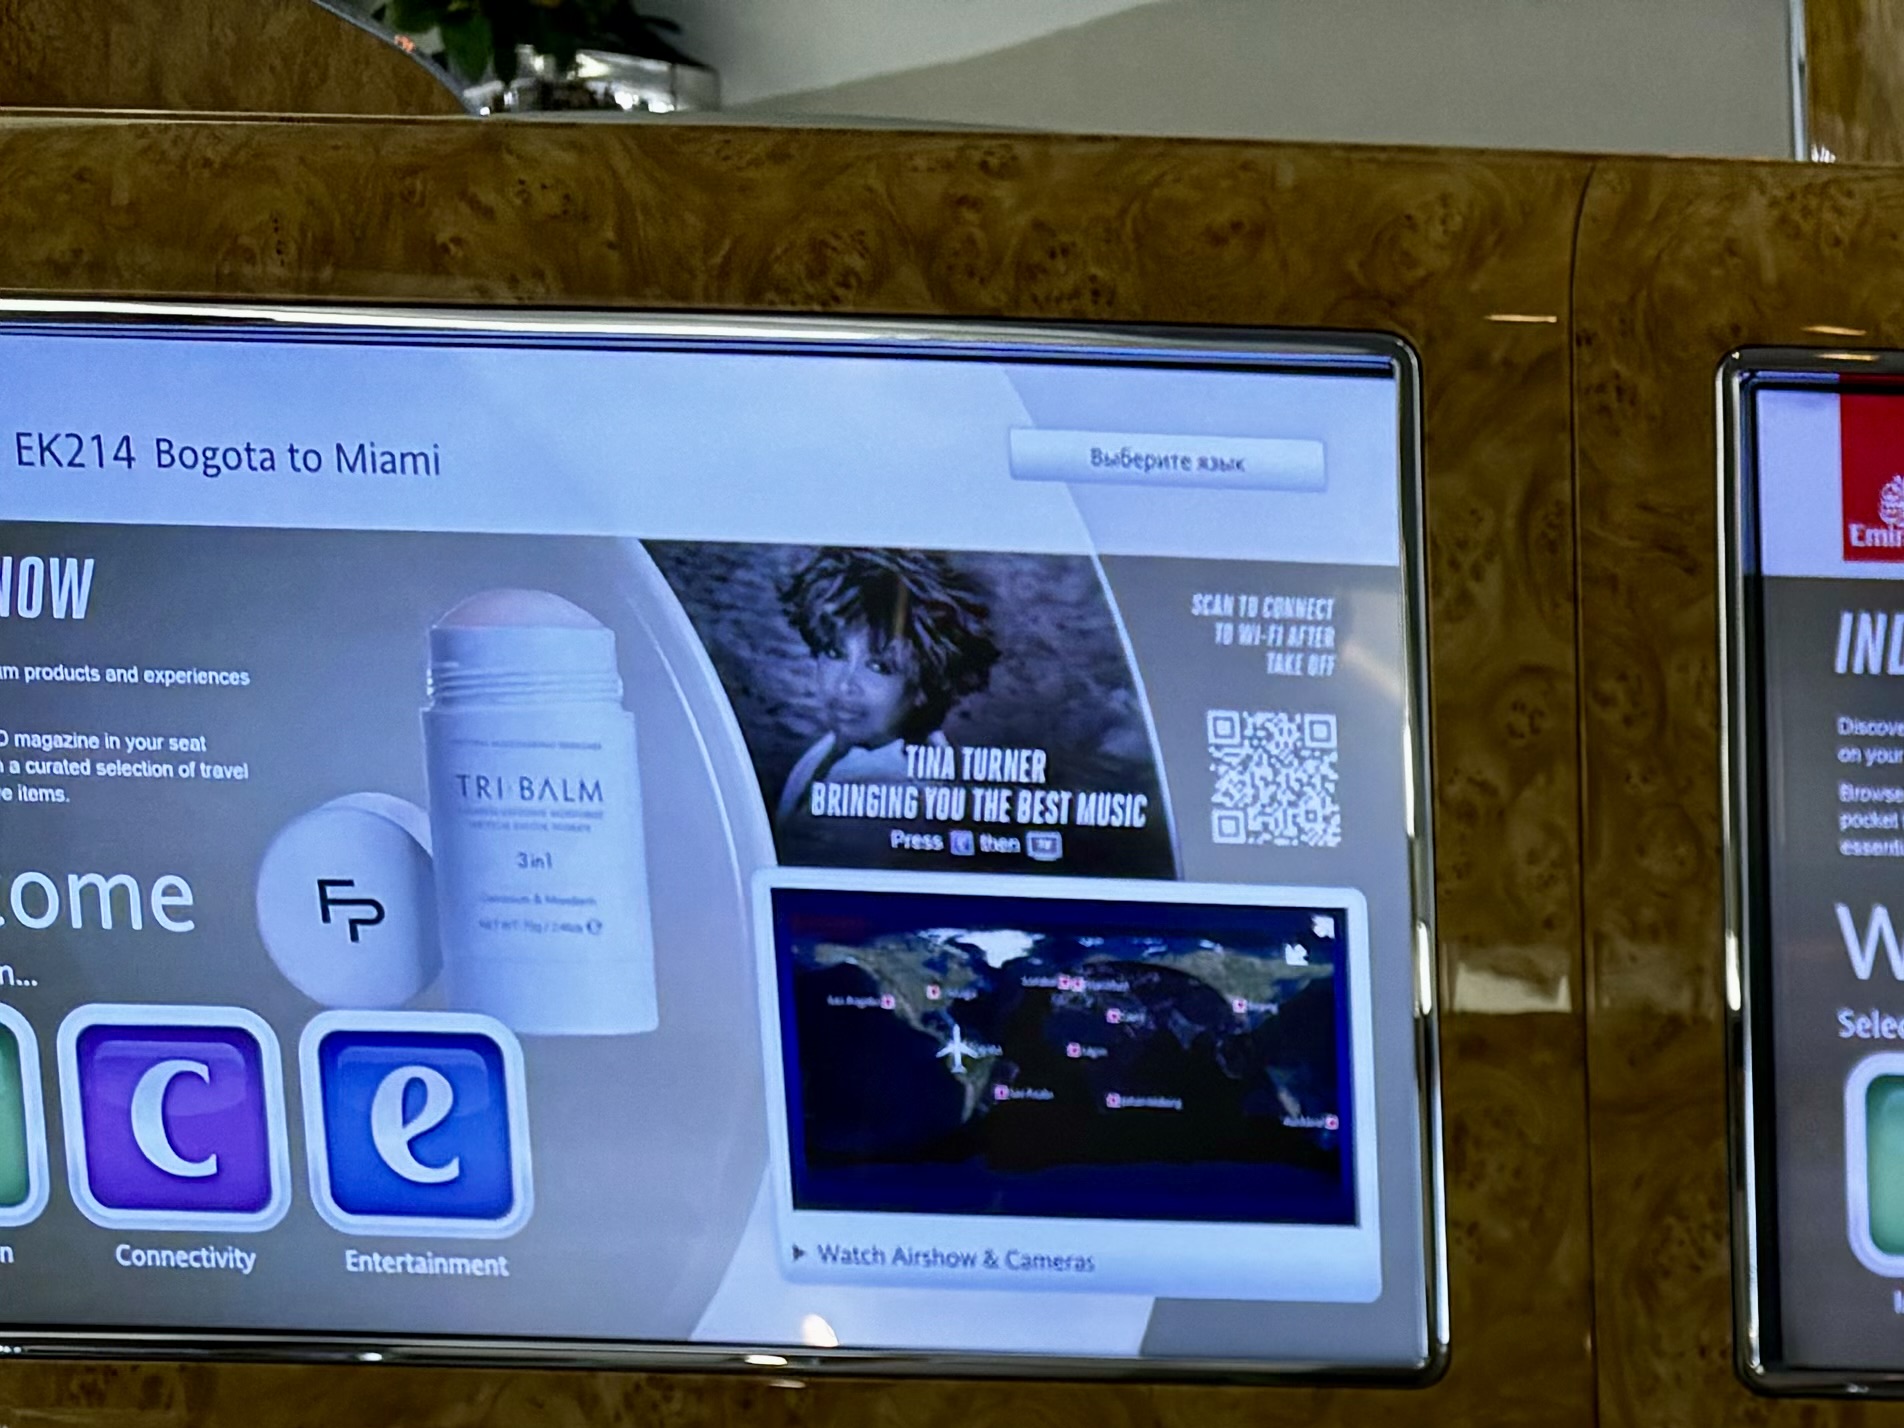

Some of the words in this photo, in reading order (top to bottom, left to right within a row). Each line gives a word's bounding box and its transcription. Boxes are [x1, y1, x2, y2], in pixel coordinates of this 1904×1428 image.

[15, 432, 136, 469] EK214
[155, 437, 276, 477] Bogota
[288, 443, 322, 473] to
[336, 442, 441, 476] Miami
[1090, 447, 1192, 473] Выберите
[1197, 455, 1245, 472] язык
[1191, 593, 1234, 616] SCAN
[1238, 595, 1259, 618] TO
[1262, 596, 1335, 620] CONNECT
[1215, 622, 1233, 645] TO
[1238, 623, 1283, 647] WI-FI
[1286, 625, 1335, 649] AFTER
[25, 665, 100, 683] products
[105, 666, 138, 683] and
[144, 667, 250, 686] experiences
[1266, 652, 1303, 675] TAKE
[1307, 653, 1335, 676] OFF
[14, 733, 99, 751] magazine
[105, 733, 120, 749] in
[125, 735, 164, 753] your
[169, 736, 206, 751] seat
[10, 760, 20, 774] a
[25, 758, 91, 775] curated
[96, 760, 173, 778] selection
[178, 761, 195, 778] of
[200, 762, 248, 779] travel
[905, 744, 955, 780] TINA
[961, 747, 1046, 783] TURNER
[1838, 749, 1861, 763] on
[1865, 750, 1903, 767] your
[18, 784, 70, 802] items.
[811, 782, 918, 819] BRINGING
[924, 786, 967, 821] YOU
[971, 788, 1012, 823] THE
[1016, 790, 1073, 825] BEST
[1076, 792, 1148, 828] MUSIC
[1839, 784, 1904, 802] Browse
[1839, 812, 1900, 832] pocket
[890, 829, 944, 851] Press
[979, 832, 1021, 853] then
[116, 1244, 257, 1275] Connectivity
[345, 1250, 510, 1278] Entertainment
[817, 1243, 886, 1266] Watch
[891, 1246, 978, 1269] Airshow
[982, 1248, 1001, 1270] &
[1004, 1249, 1096, 1272] Cameras
